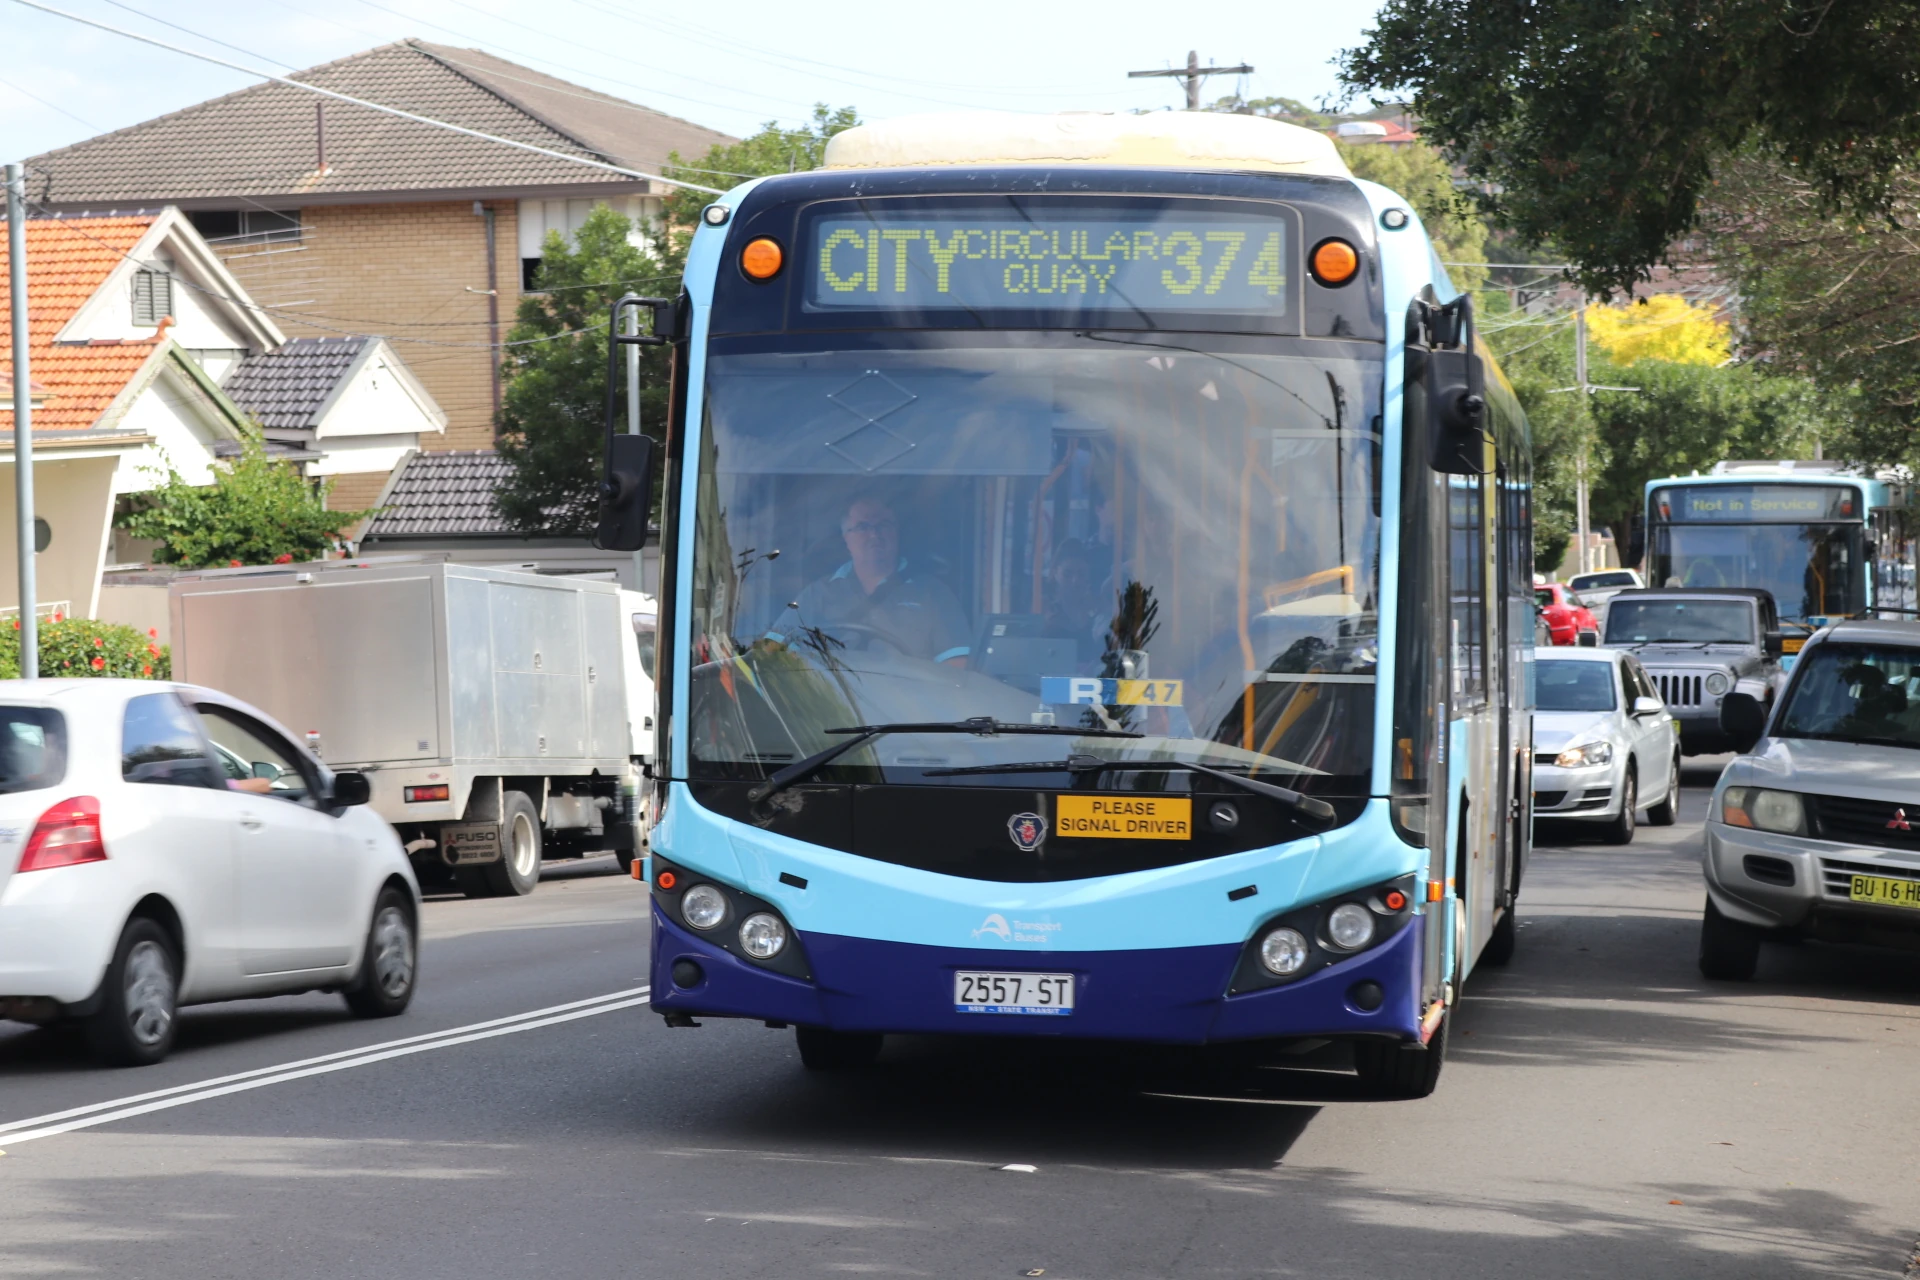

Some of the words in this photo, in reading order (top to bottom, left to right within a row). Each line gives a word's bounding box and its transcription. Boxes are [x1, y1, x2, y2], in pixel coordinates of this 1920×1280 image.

[820, 229, 964, 292] CITY
[964, 230, 1160, 260] CIRCULAR
[1161, 231, 1286, 295] 374
[1004, 264, 1116, 293] QUAY
[1693, 499, 1723, 511] Not
[1729, 500, 1744, 511] in
[1751, 499, 1818, 511] Service
[1092, 802, 1156, 816] PLEASE
[1060, 818, 1121, 832] SIGNAL
[1126, 820, 1187, 834] DRIVER
[456, 832, 495, 842] FUSO
[1013, 920, 1061, 931] Transport
[1015, 932, 1047, 942] Buses
